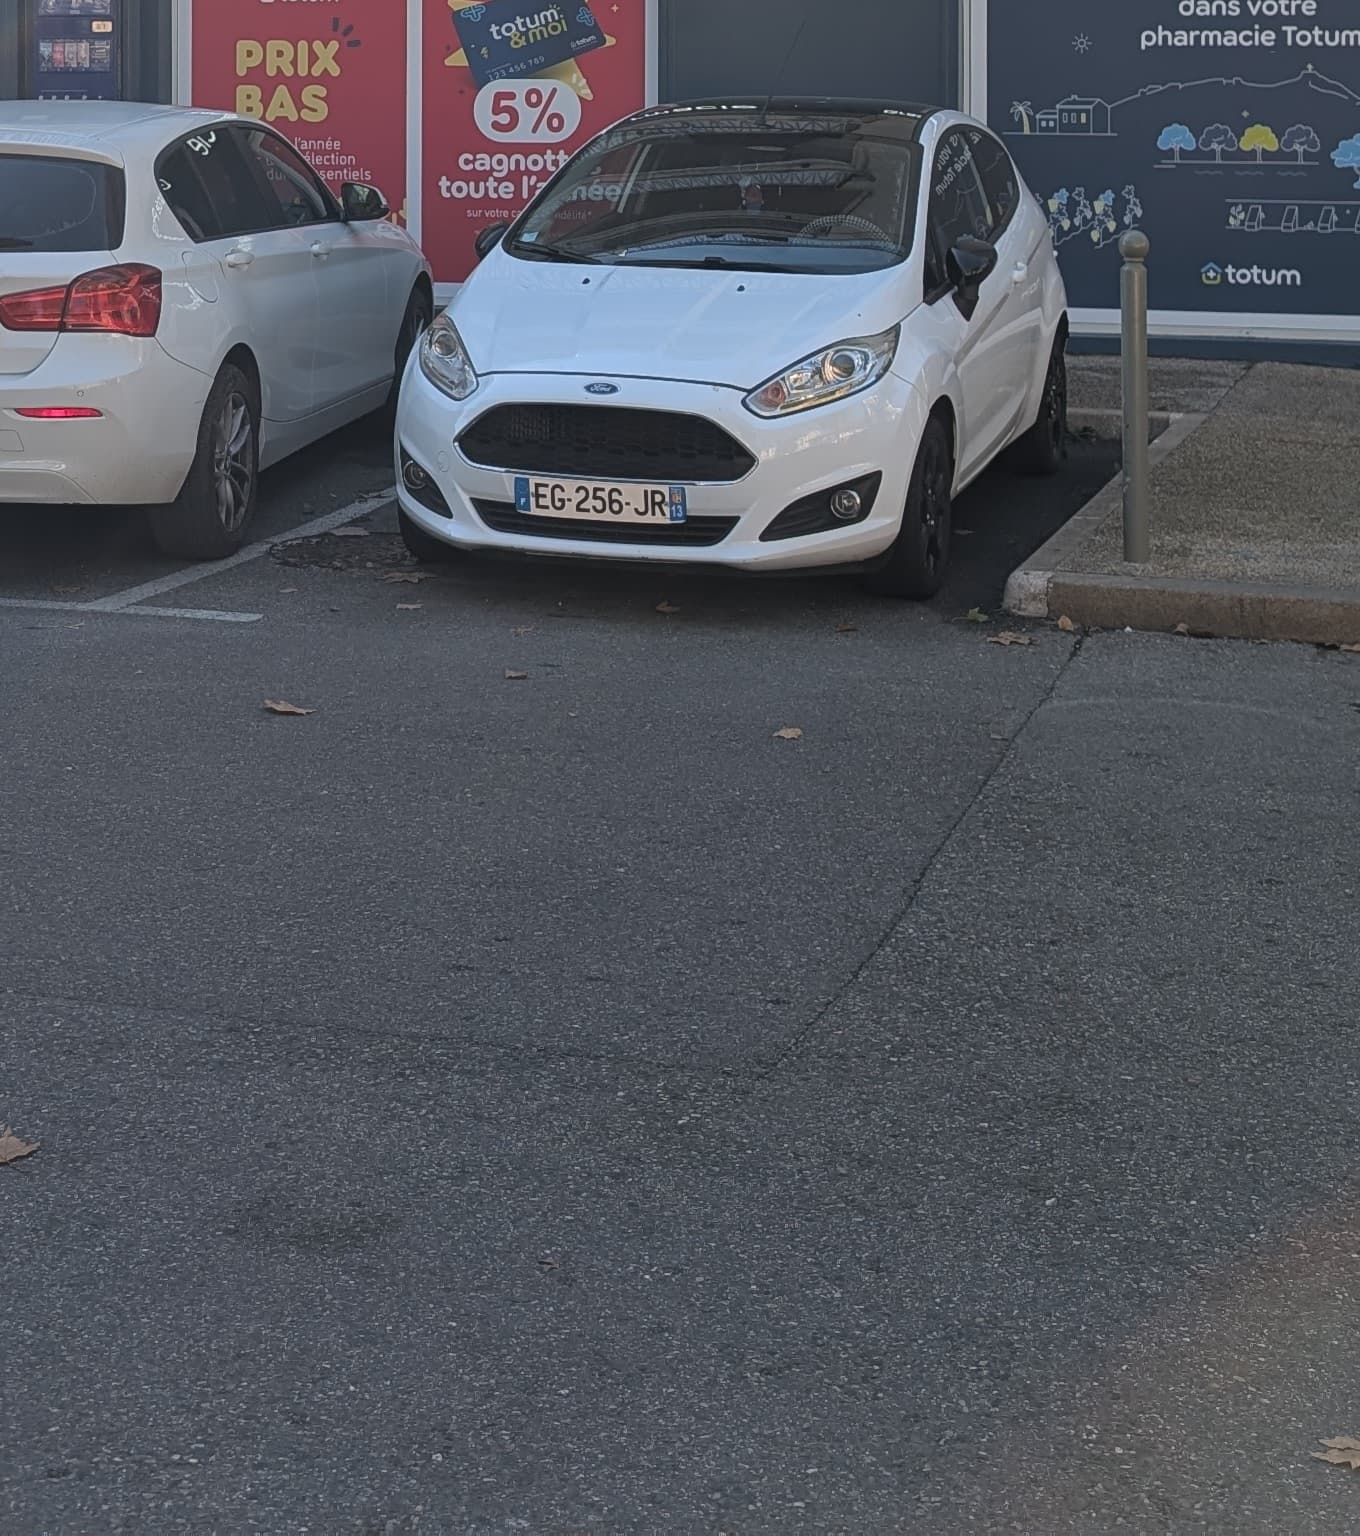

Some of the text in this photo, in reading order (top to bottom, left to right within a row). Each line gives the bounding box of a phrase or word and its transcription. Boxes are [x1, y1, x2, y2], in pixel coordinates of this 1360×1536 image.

[490, 8, 558, 40] totum
[1140, 24, 1276, 52] pharmacie
[236, 40, 340, 77] PRIX
[488, 68, 507, 81] 123
[508, 62, 527, 75] 456
[528, 55, 545, 67] 789
[236, 84, 329, 123] BAS
[491, 87, 565, 134] 5%
[305, 152, 356, 165] élection
[319, 168, 372, 181] sentiels
[438, 175, 515, 199] toute
[466, 209, 482, 218] sur
[484, 208, 509, 218] votre
[1225, 264, 1301, 287] totum
[590, 383, 612, 393] Ford
[534, 482, 667, 517] EG-256-JR
[671, 505, 683, 518] 13
